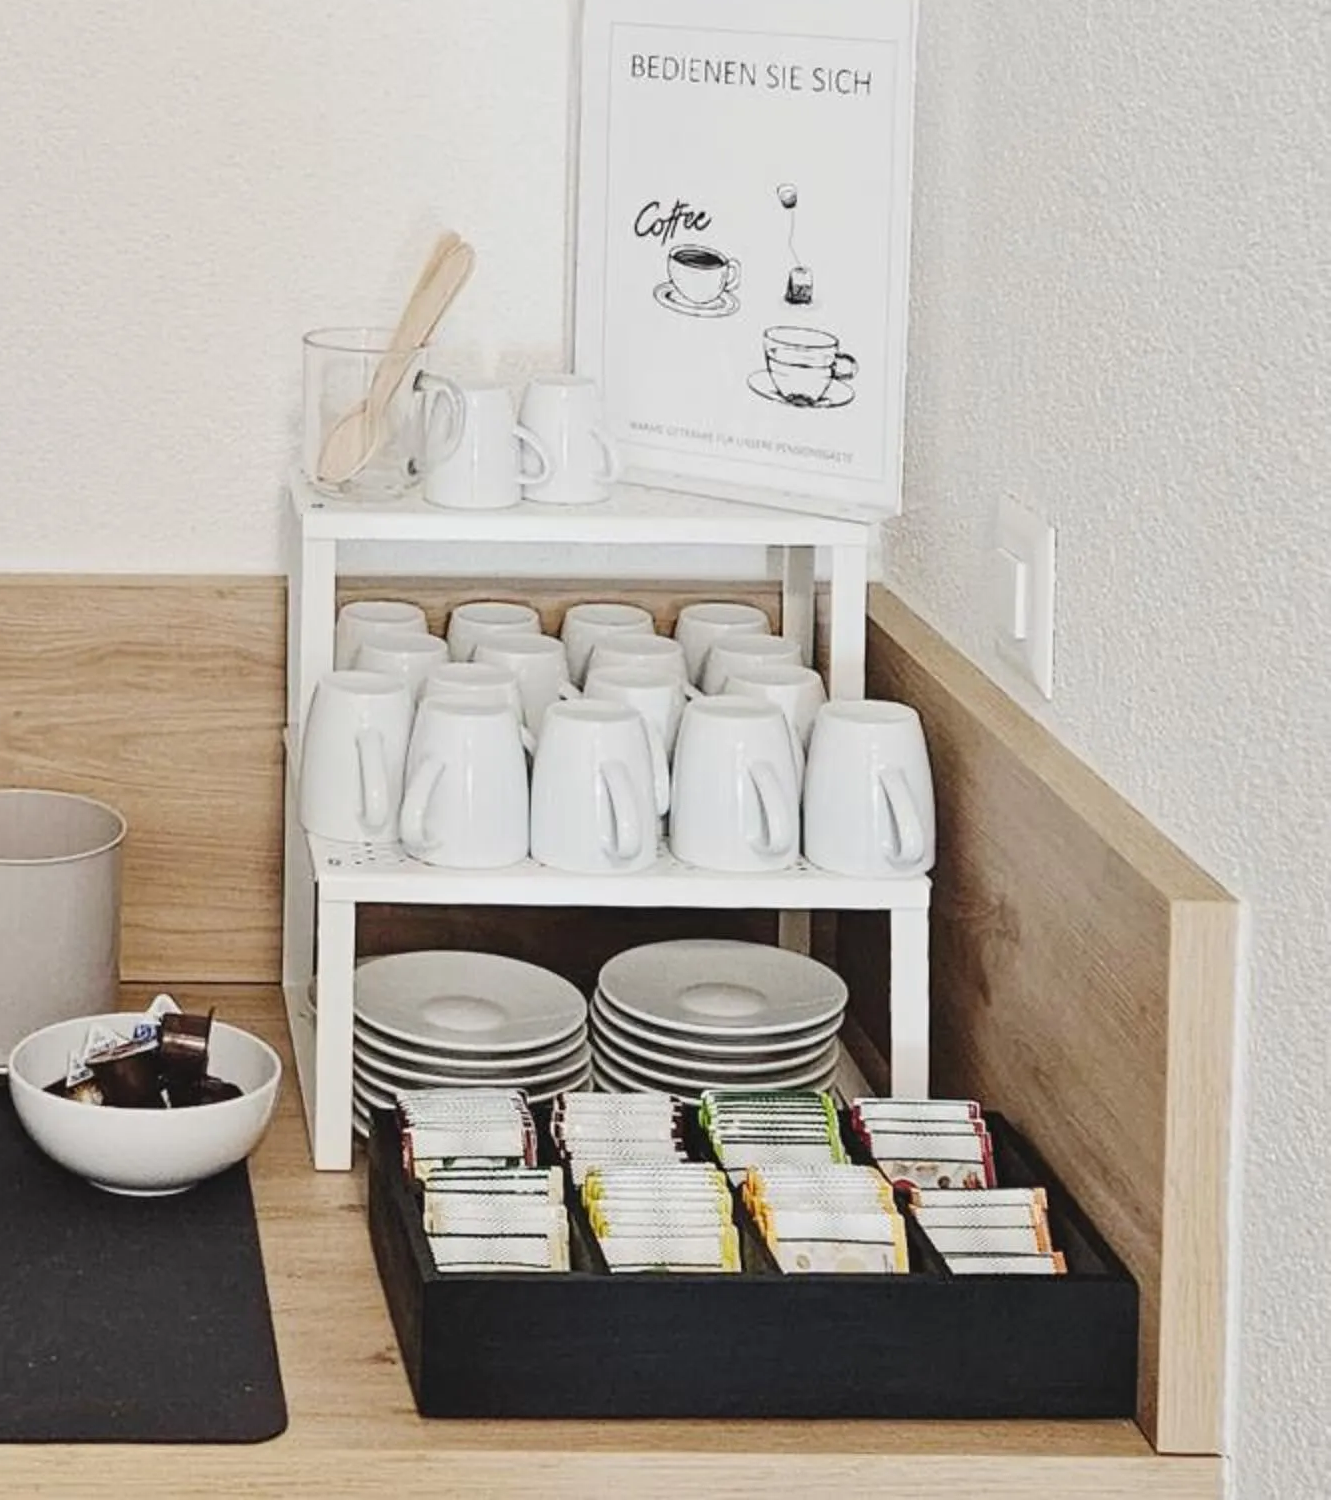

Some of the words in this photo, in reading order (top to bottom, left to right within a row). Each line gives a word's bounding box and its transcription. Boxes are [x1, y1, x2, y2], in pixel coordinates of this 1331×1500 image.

[630, 54, 757, 86] BEDIENEN
[765, 63, 803, 91] SIE
[812, 66, 873, 96] SICH
[633, 199, 711, 247] Coffee
